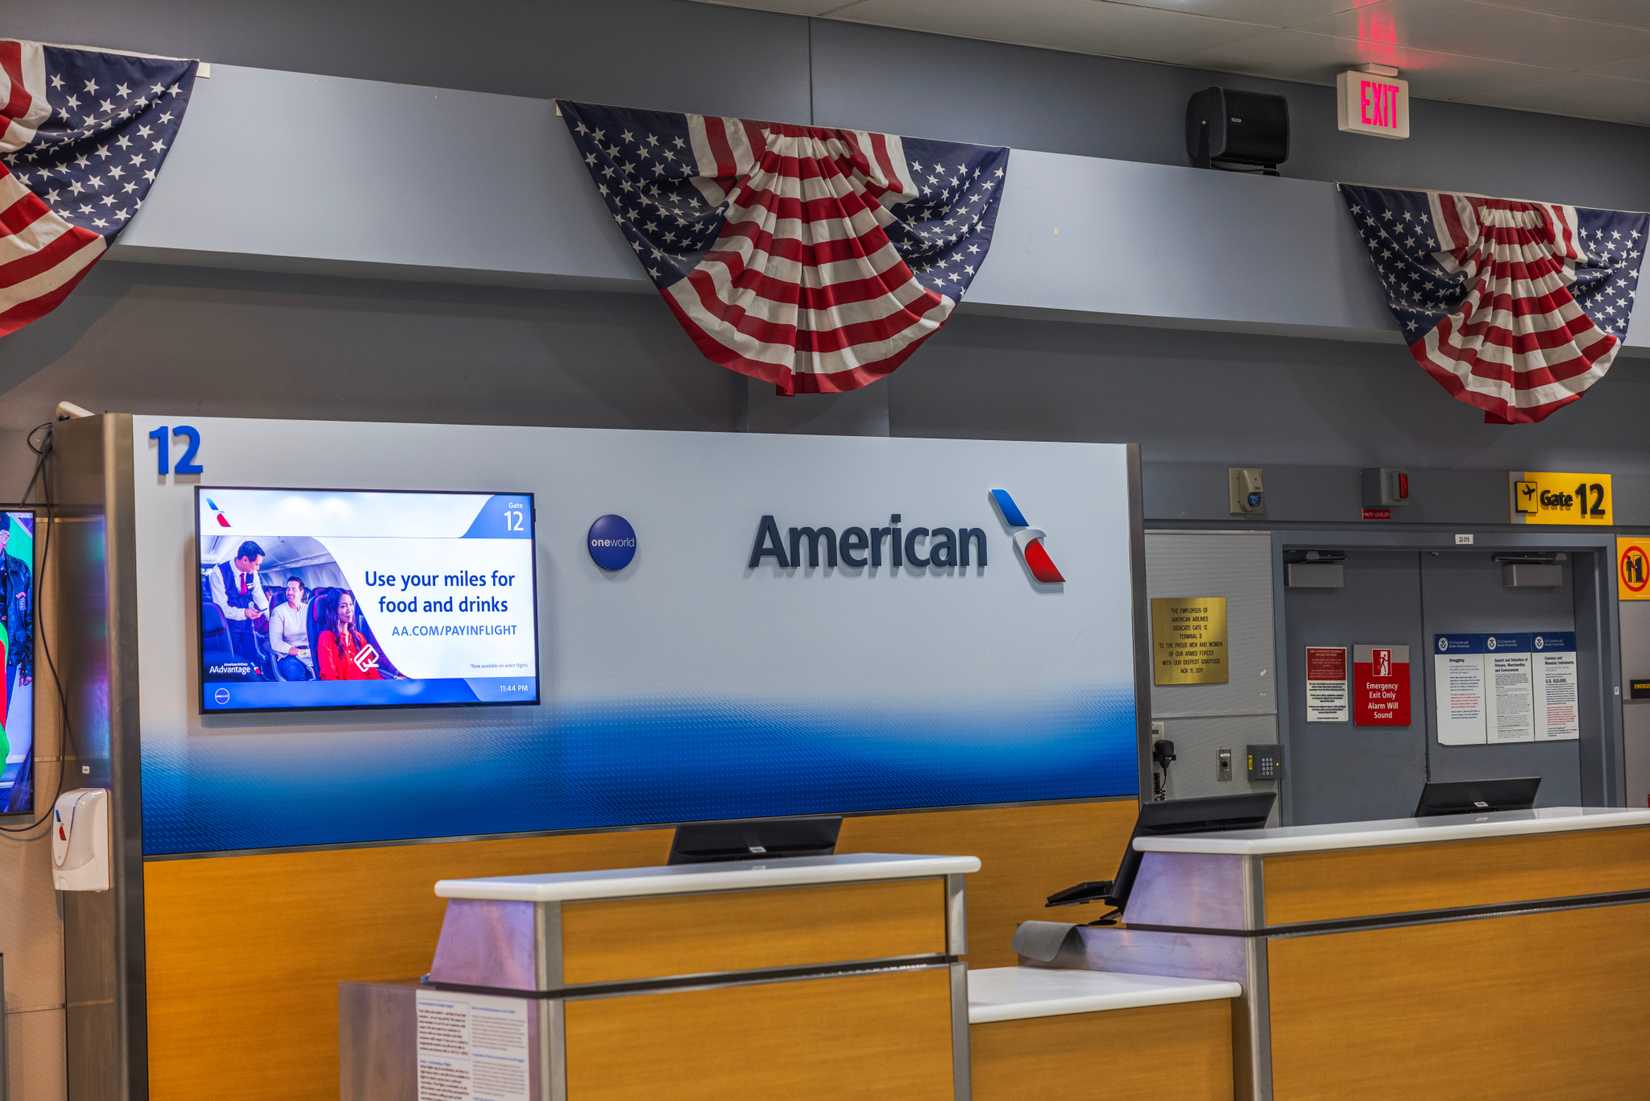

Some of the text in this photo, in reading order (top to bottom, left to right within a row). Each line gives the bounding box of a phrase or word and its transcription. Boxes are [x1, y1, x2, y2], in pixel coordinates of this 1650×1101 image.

[1360, 80, 1400, 129] EXIT
[148, 425, 204, 476] 12
[1540, 483, 1606, 516] Gate 12
[503, 511, 525, 532] 12
[591, 536, 636, 548] oneworld
[748, 513, 988, 568] American
[364, 569, 516, 592] Use your miles for
[378, 595, 509, 613] food and drinks
[391, 624, 518, 637] AA.COM/PAYINFLIGHT
[208, 665, 251, 676] AAdvantage
[517, 684, 529, 692] PM
[1365, 682, 1399, 691] Emergency
[1369, 691, 1397, 700] Exit Only
[1367, 702, 1399, 710] Alarm Will
[1373, 711, 1393, 719] Sound
